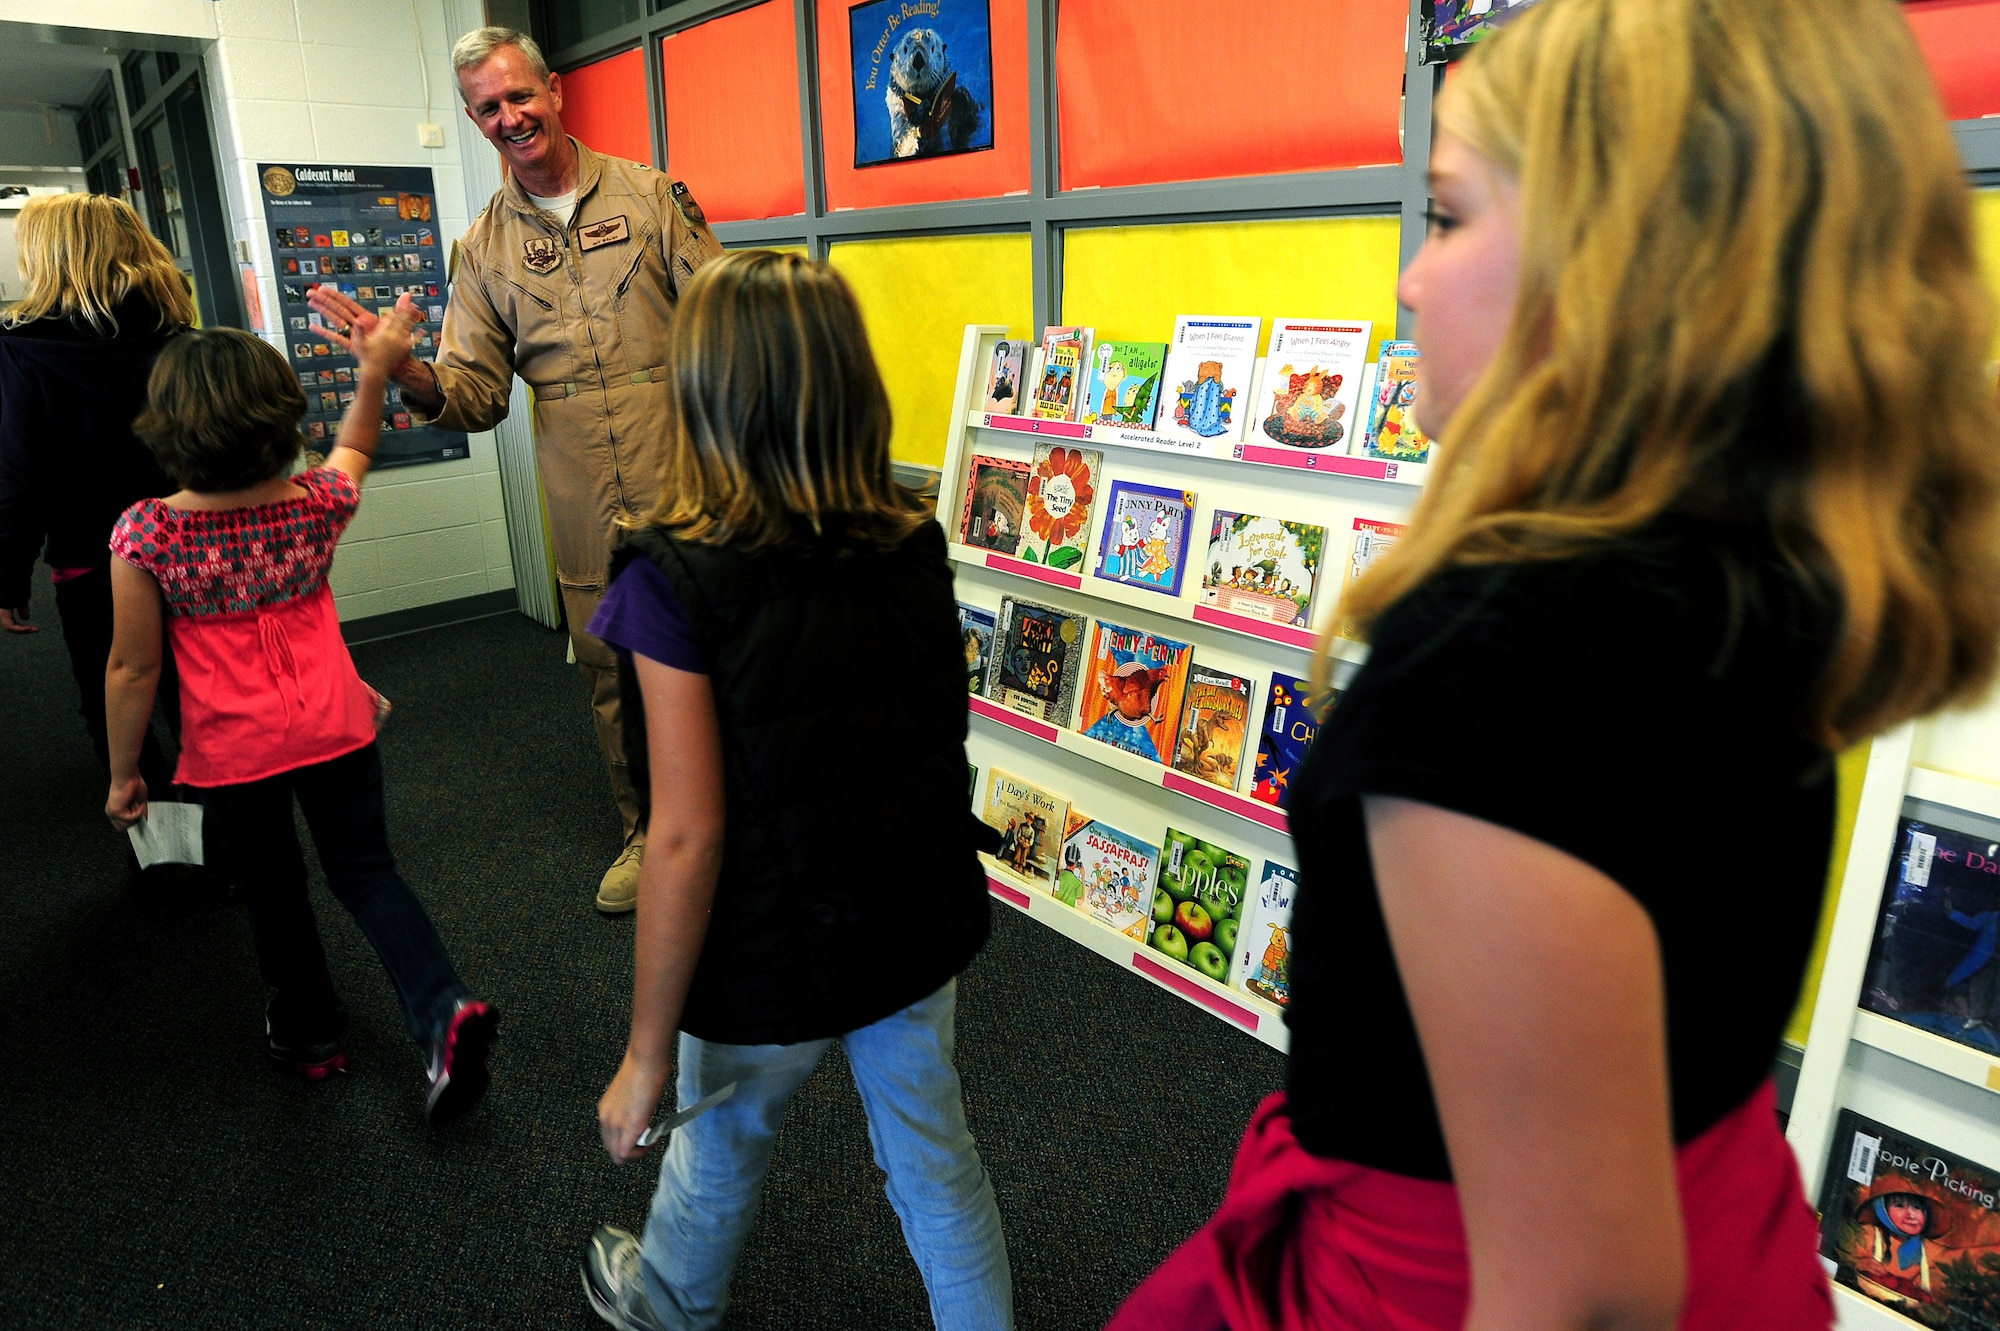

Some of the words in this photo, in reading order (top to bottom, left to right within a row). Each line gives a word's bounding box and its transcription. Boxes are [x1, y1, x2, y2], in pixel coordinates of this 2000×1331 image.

[901, 0, 941, 20] Reading!
[887, 14, 901, 32] Be
[871, 28, 890, 64] Otter
[865, 66, 879, 91] You
[294, 167, 331, 182] Caldecott
[332, 168, 356, 182] Medal
[1189, 333, 1206, 341] When
[1223, 333, 1244, 342] Scared
[1290, 337, 1309, 346] When
[1311, 337, 1314, 345] I
[1315, 337, 1329, 345] Feel
[1329, 338, 1351, 348] Angry
[1123, 345, 1129, 356] I
[1129, 346, 1139, 354] AM
[1129, 356, 1158, 371] alligator
[1119, 432, 1154, 443] Accelerated
[1155, 438, 1177, 446] Reader
[1178, 439, 1195, 448] Level
[1046, 492, 1059, 502] The
[1060, 495, 1074, 507] Tiny
[1051, 503, 1067, 513] Seed
[1124, 499, 1153, 510] UNNY
[1155, 500, 1185, 521] PARTY
[1238, 527, 1286, 550] Lemonade
[1247, 542, 1263, 562] for
[1264, 540, 1288, 560] Sale
[1110, 631, 1185, 666] ENNY-PENNY
[1006, 782, 1030, 801] Day's
[1032, 793, 1055, 813] Work
[1086, 834, 1149, 871] SASSAFRAS!
[1965, 850, 2000, 875] Da
[1877, 1148, 1920, 1175] pple
[1921, 1156, 1995, 1210] Picking
